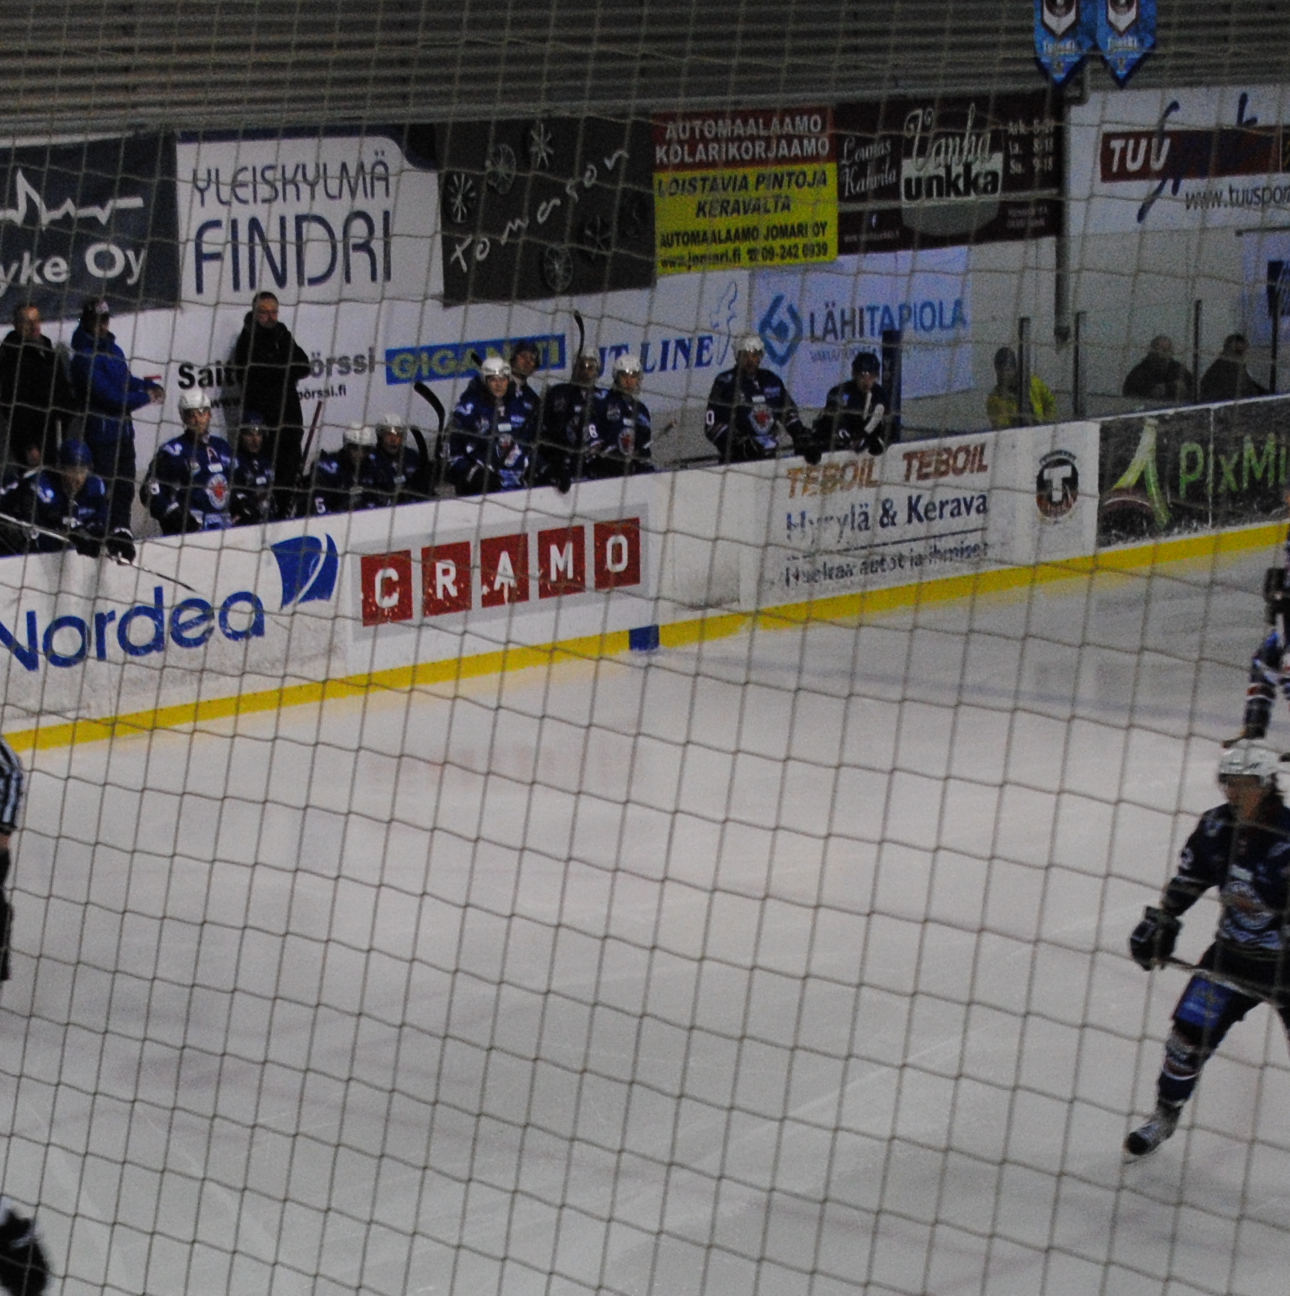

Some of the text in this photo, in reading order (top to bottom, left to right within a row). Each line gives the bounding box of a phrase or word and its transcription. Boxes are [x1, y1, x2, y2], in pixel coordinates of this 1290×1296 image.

[665, 114, 822, 141] AUTOMAALAAMO
[655, 137, 829, 164] KOLARIKORJAAMO
[1109, 136, 1171, 173] TUU
[192, 149, 391, 207] YLEISKYLMÄ
[658, 170, 827, 197] LOISTAVIA PINTOJA
[841, 157, 897, 197] Kahvila
[194, 210, 392, 294] FINDRI
[661, 227, 759, 248] AUTOMAALAAMO
[764, 222, 808, 241] JOMARI
[813, 221, 828, 237] OY
[84, 241, 147, 287] Oy
[809, 298, 967, 342] LÄHITAPIOLA
[391, 339, 559, 380] GIGATI
[641, 335, 714, 374] LINE
[787, 443, 989, 498] TEBOIL TEBOIL
[879, 497, 898, 529] &
[907, 493, 989, 525] Kerava
[373, 532, 629, 610] CRAMO
